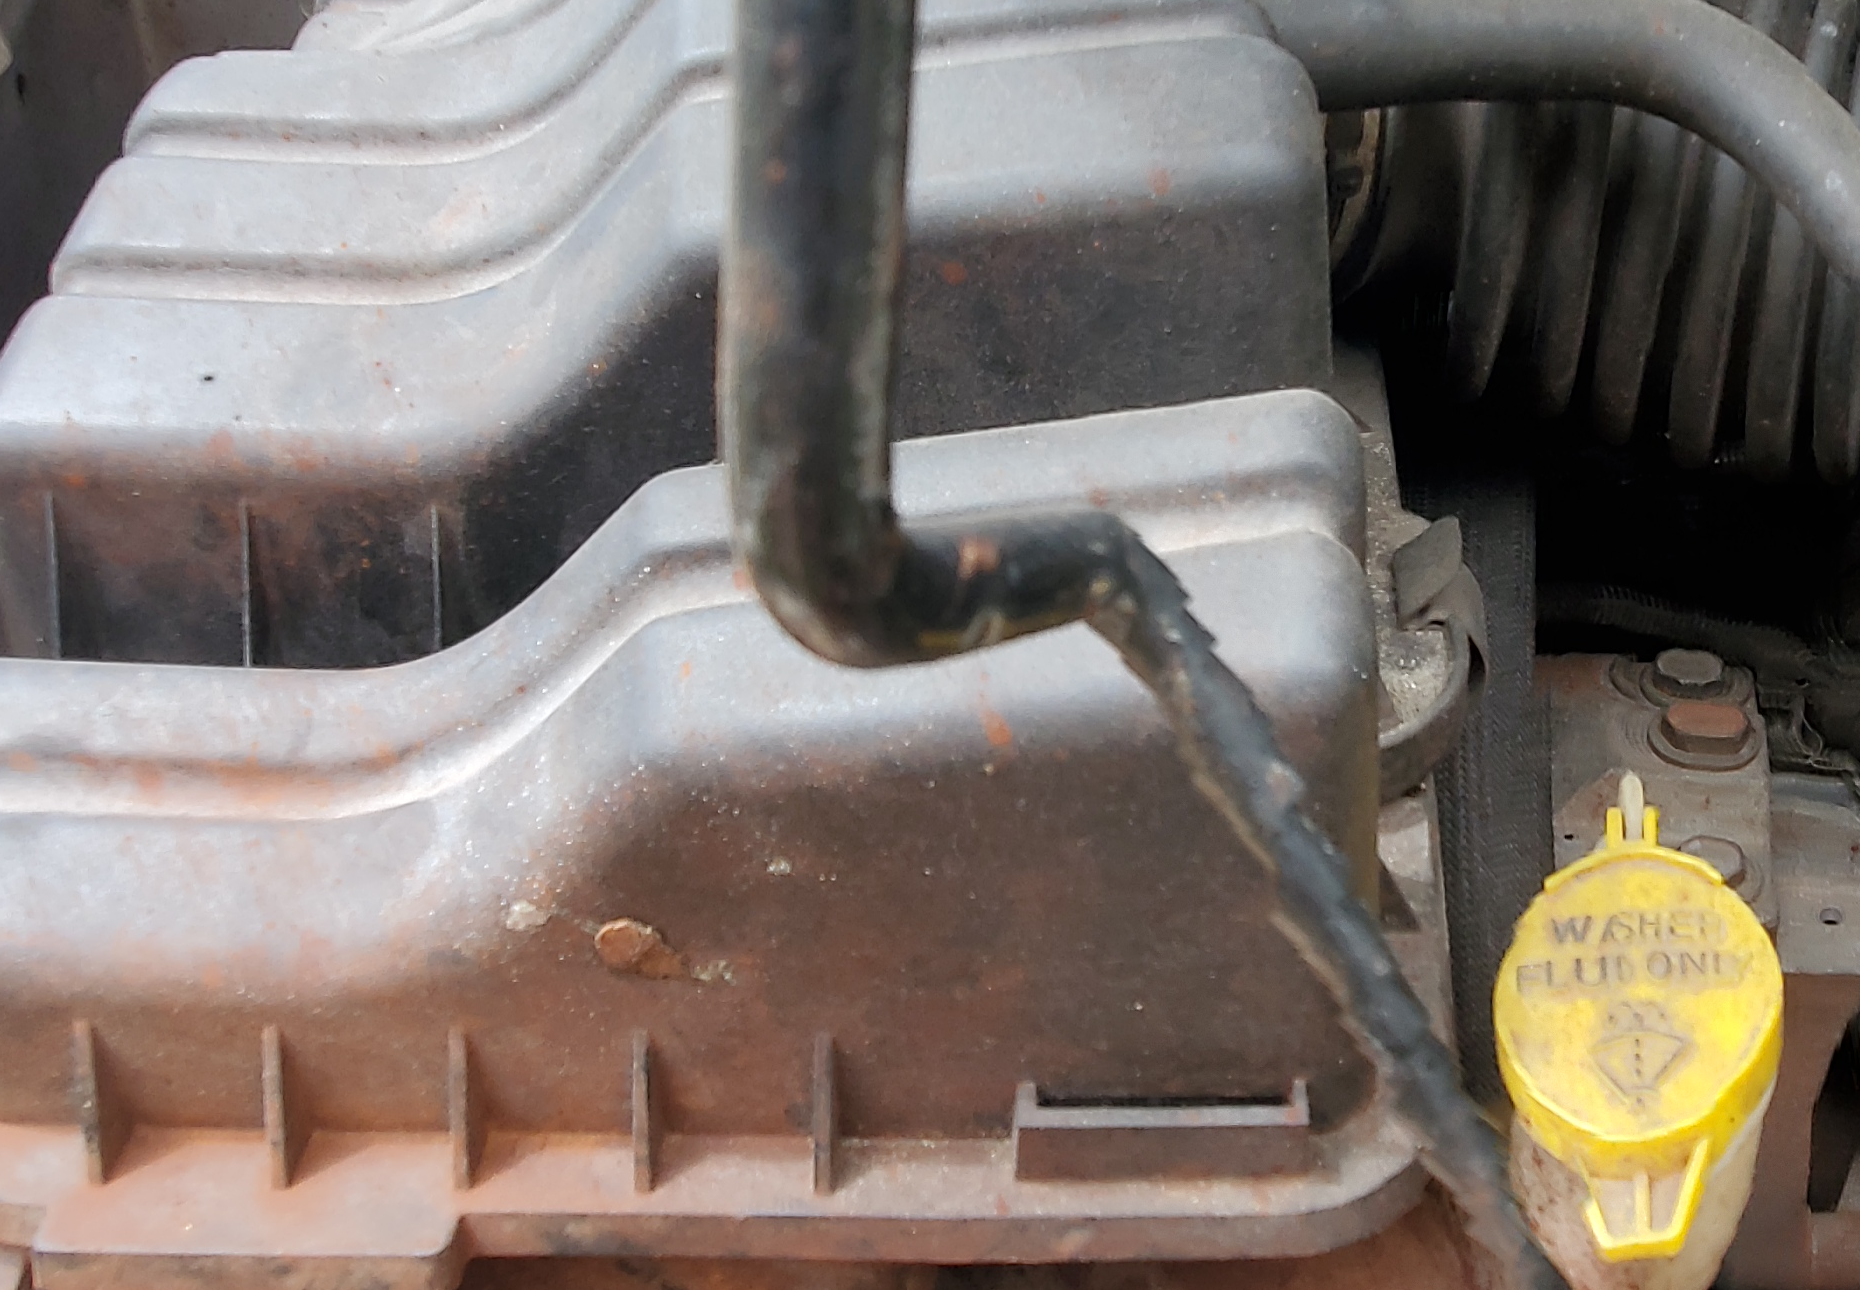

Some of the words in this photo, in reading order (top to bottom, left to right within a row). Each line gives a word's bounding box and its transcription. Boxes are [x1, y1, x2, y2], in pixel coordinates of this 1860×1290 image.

[1550, 910, 1728, 944] WASHER
[1516, 954, 1635, 992] FLUID
[1645, 951, 1752, 986] ONLY
